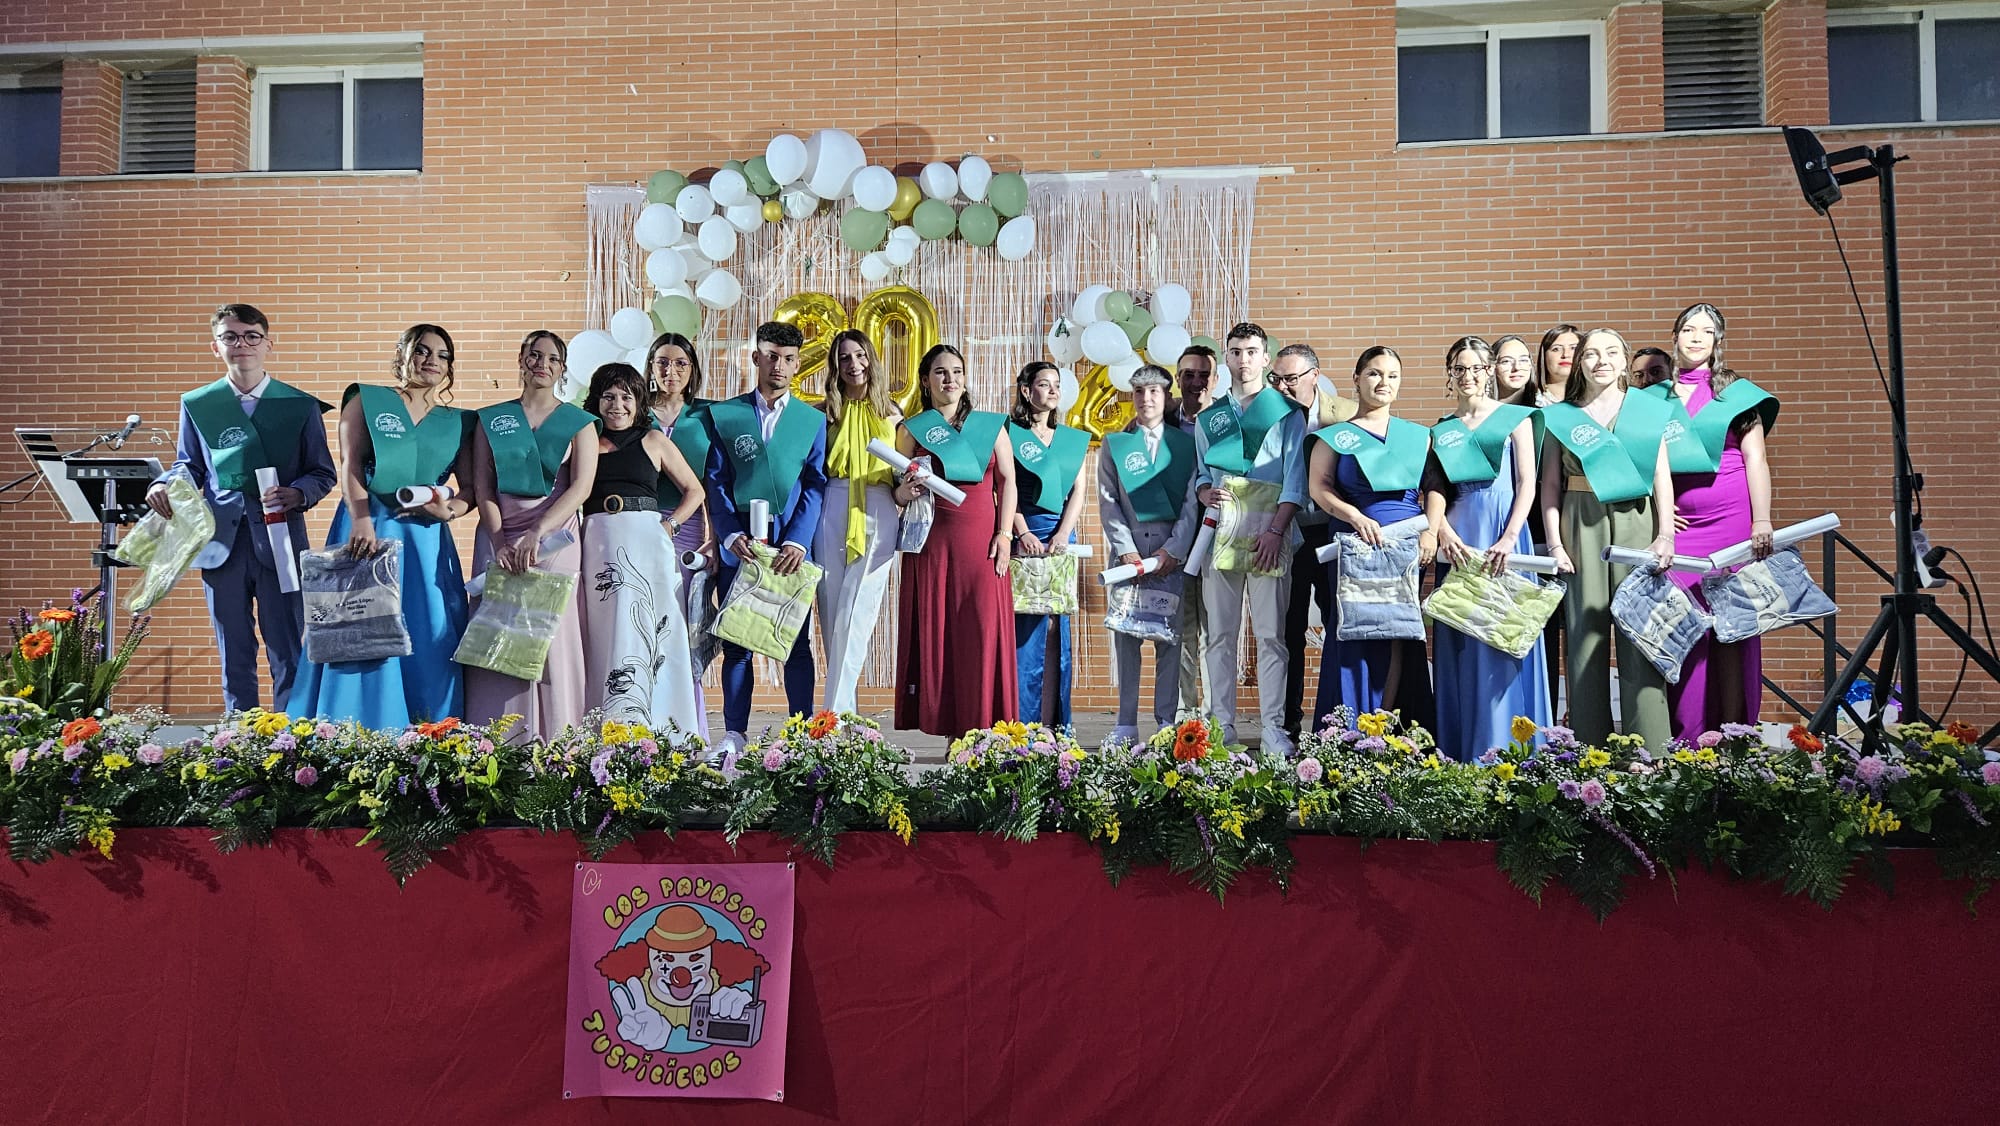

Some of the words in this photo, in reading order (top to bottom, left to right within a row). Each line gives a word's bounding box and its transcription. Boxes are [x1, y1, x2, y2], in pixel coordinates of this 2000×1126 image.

[772, 284, 941, 420] 20
[603, 883, 650, 930] LOS
[659, 876, 767, 940] PAYASOS
